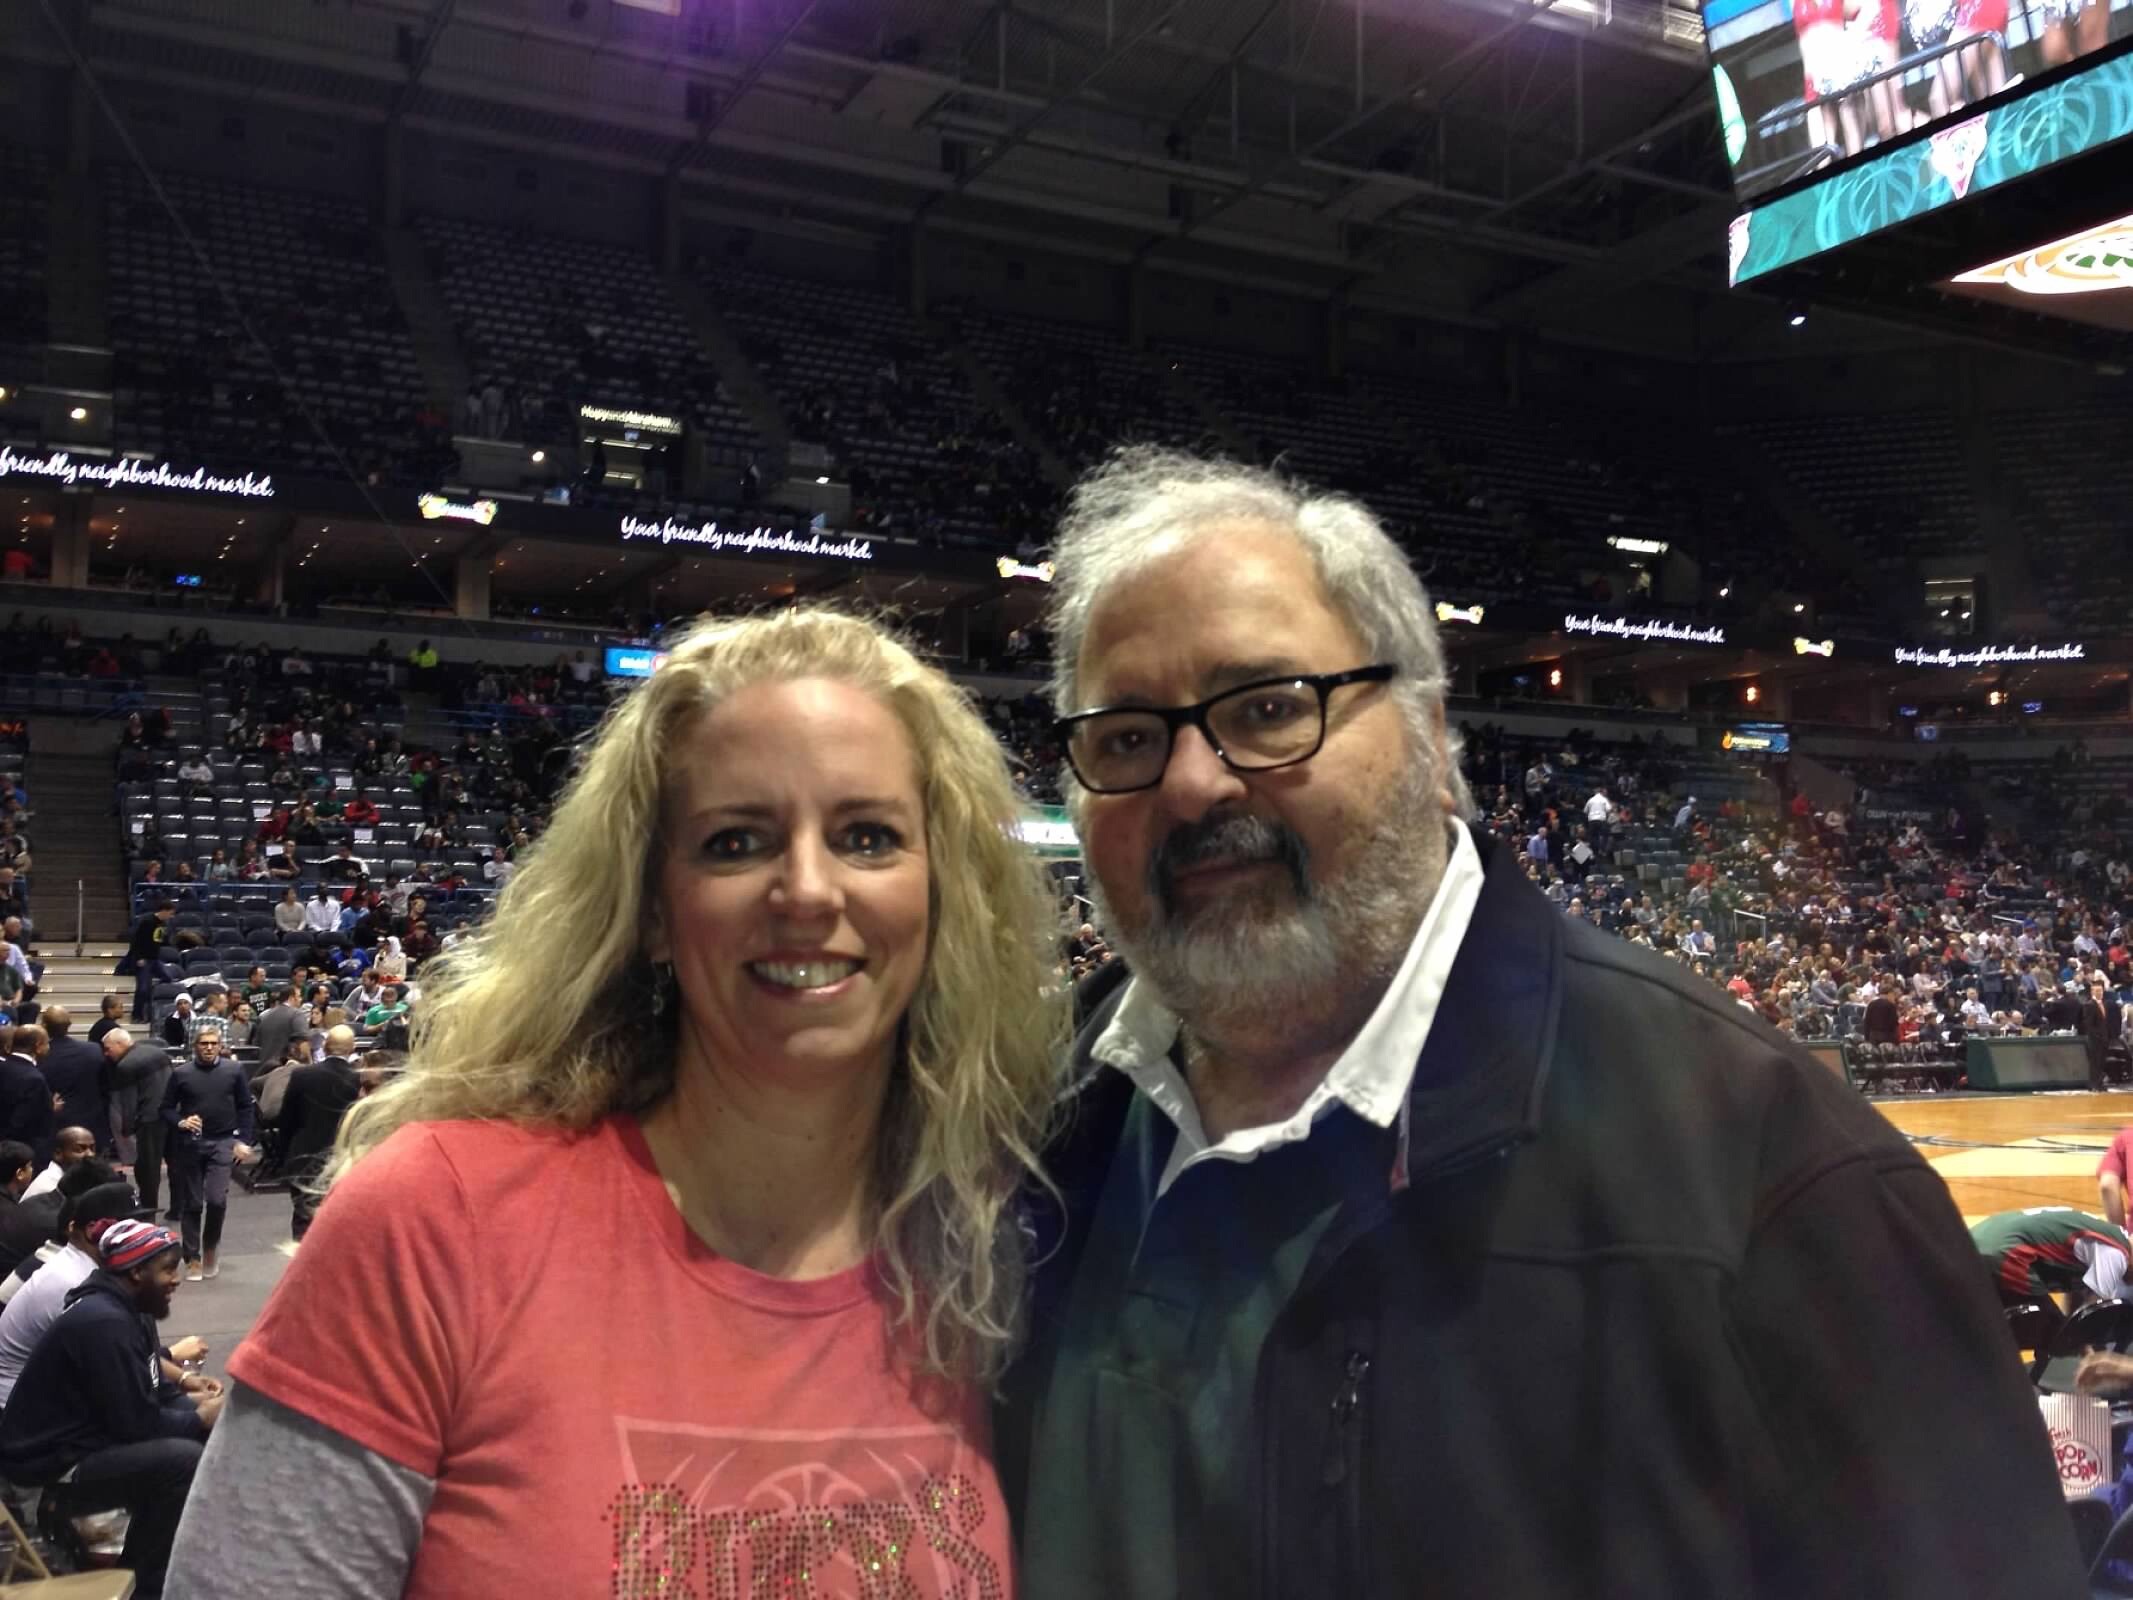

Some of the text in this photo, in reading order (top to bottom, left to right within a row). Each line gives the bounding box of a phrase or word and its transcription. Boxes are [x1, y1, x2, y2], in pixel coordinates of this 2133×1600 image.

[0, 445, 77, 484] friendly
[78, 458, 204, 490] neighborhood
[621, 515, 662, 540] Your
[662, 516, 723, 550] friendly
[723, 526, 820, 553] neighborhood
[1564, 614, 1591, 633] Your
[1591, 614, 1629, 639] friendly
[1629, 619, 1691, 641] neighborhood
[1957, 645, 2039, 667] neighborhood
[2056, 1444, 2086, 1465] POP
[2060, 1460, 2098, 1481] CORN
